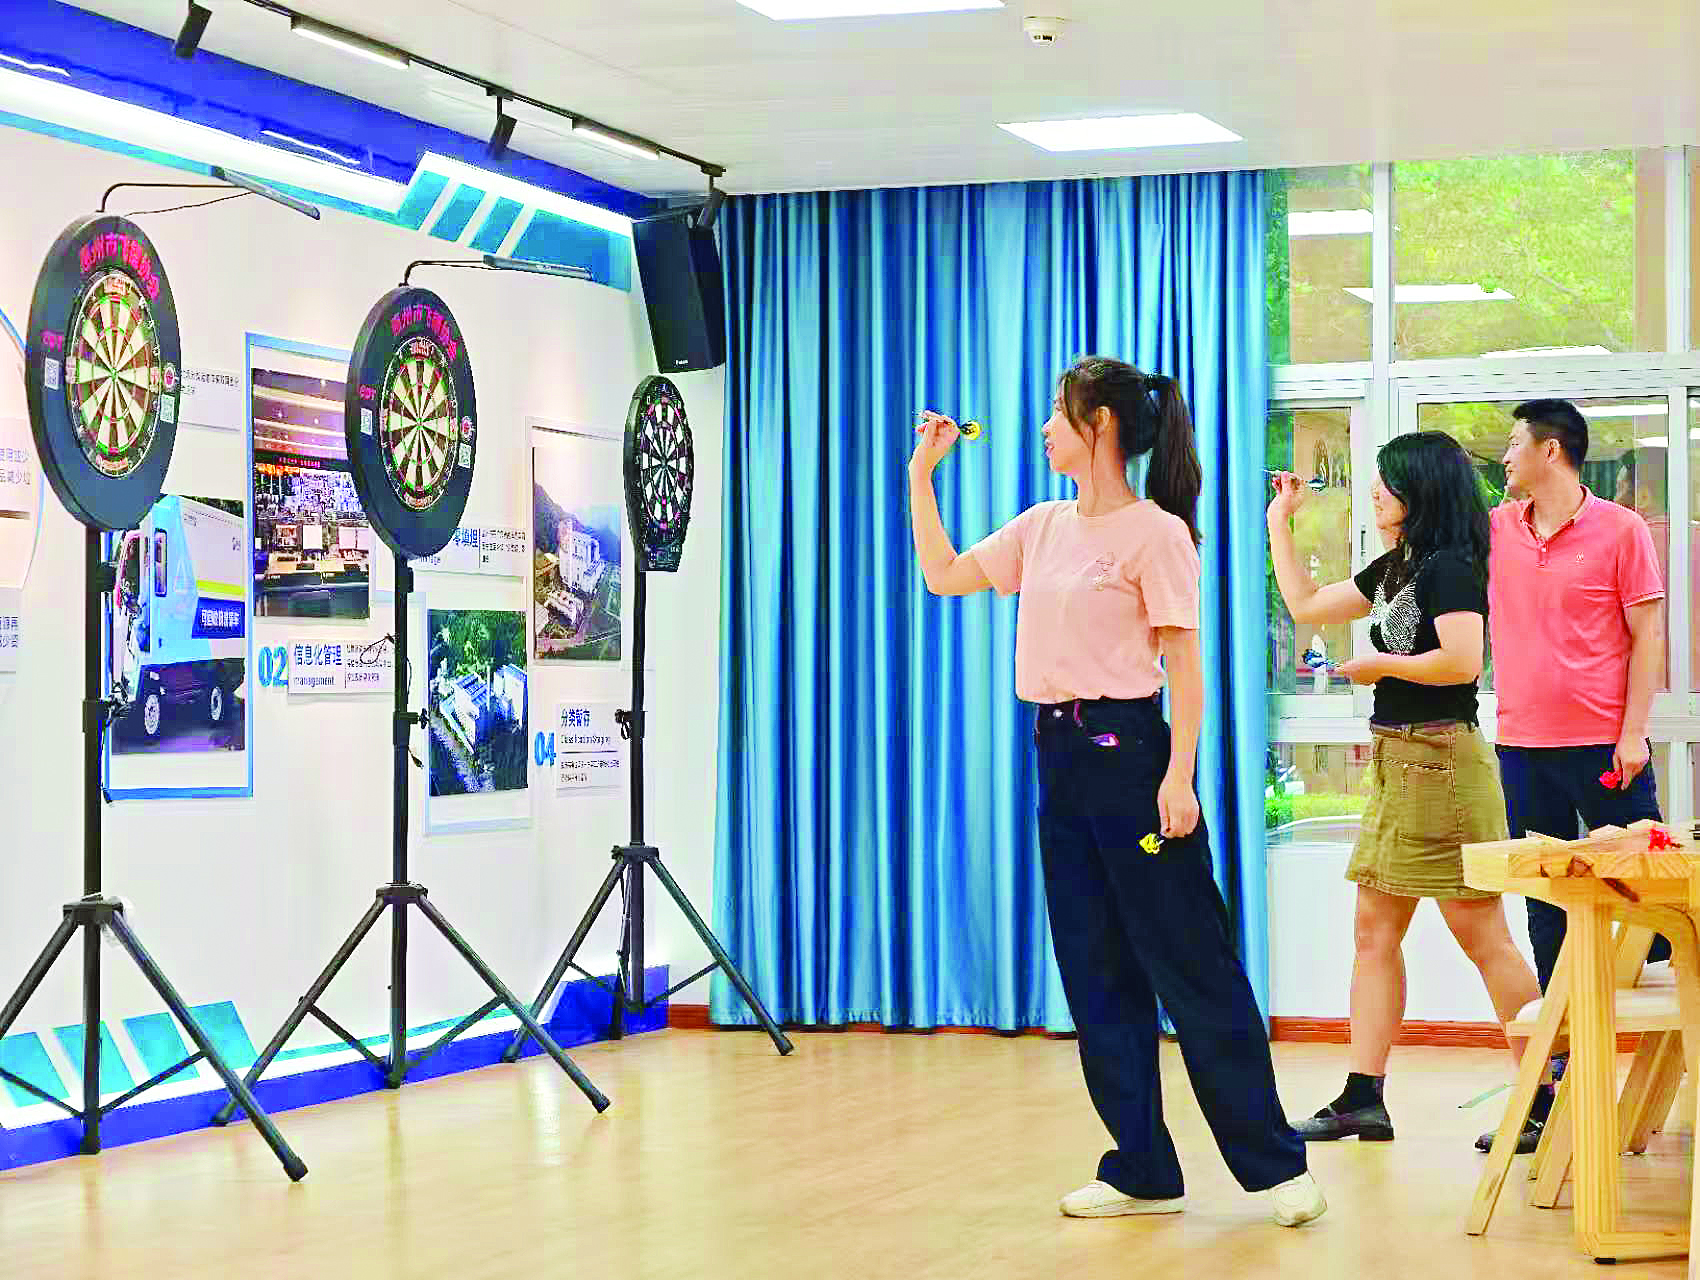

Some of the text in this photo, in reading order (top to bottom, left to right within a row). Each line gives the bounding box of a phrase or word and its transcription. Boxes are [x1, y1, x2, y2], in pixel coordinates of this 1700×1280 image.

[258, 646, 288, 688] 02
[294, 643, 343, 666] 信息化管理
[560, 708, 591, 728] 分类暂存
[534, 731, 557, 767] 04
